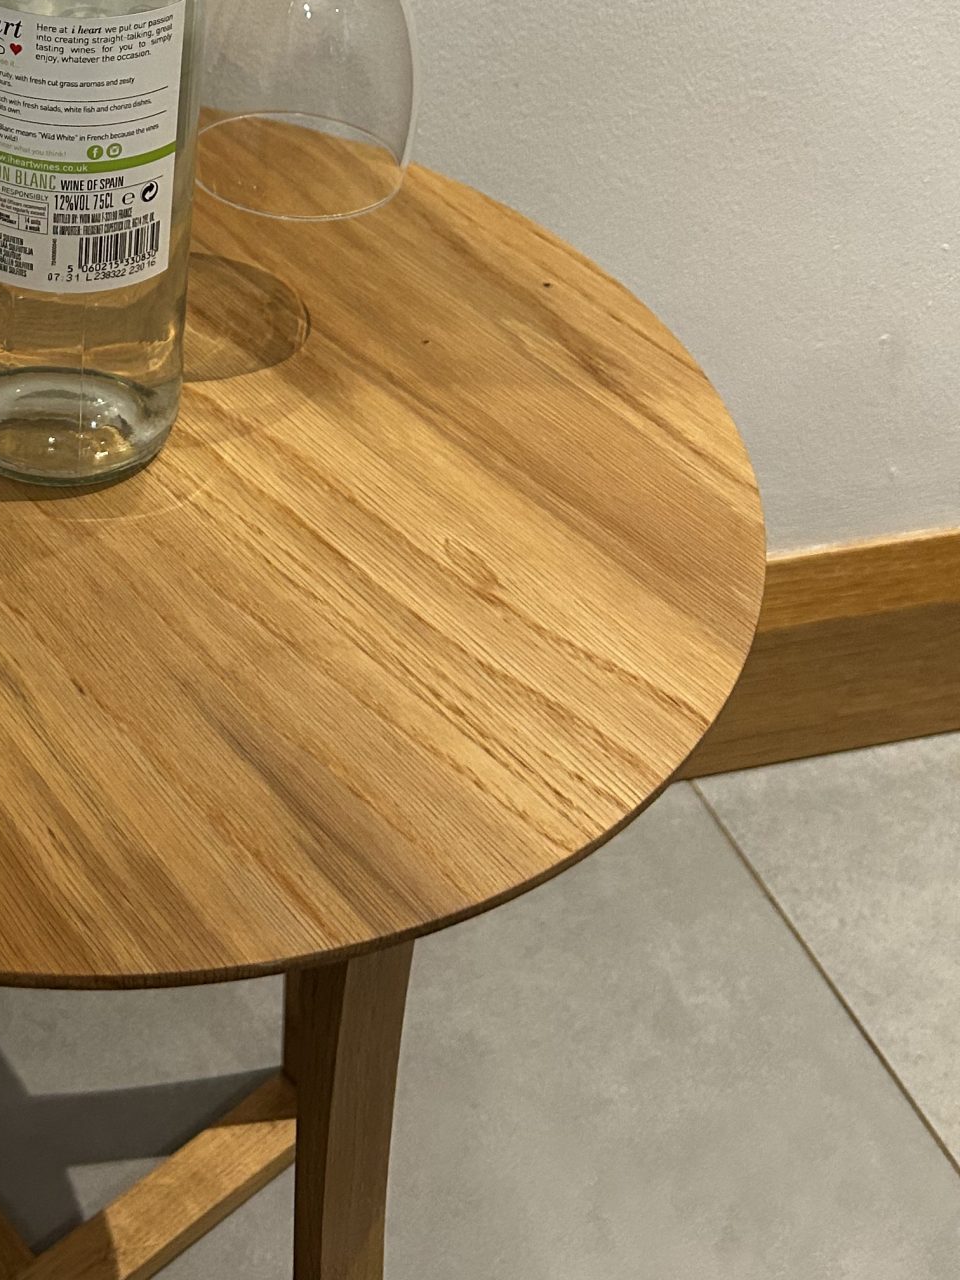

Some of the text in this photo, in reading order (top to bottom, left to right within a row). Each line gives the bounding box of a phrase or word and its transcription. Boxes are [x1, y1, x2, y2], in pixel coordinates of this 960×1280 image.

[36, 23, 57, 33] Here
[78, 25, 102, 34] heart
[119, 24, 132, 35] put
[133, 21, 147, 29] our
[148, 14, 173, 28] passion
[36, 35, 52, 43] into
[54, 35, 89, 46] creating
[155, 23, 173, 36] great
[36, 43, 64, 54] tasting
[102, 45, 113, 53] for
[119, 43, 133, 53] you
[151, 32, 173, 46] simply
[61, 55, 100, 64] whatever
[102, 54, 115, 62] the
[117, 49, 152, 61] occasion.
[15, 74, 28, 82] with
[29, 76, 47, 85] fresh
[59, 81, 79, 89] grass
[106, 79, 118, 87] and
[119, 76, 136, 85] zesty
[9, 97, 22, 106] with
[22, 100, 39, 110] fresh
[96, 104, 109, 112] and
[16, 129, 37, 138] means
[86, 131, 110, 141] French
[110, 129, 135, 139] because
[135, 127, 145, 135] the
[15, 170, 57, 190] BLANC
[60, 179, 85, 191] WINE
[87, 179, 98, 190] OF
[100, 176, 124, 190] SPAIN
[1, 186, 49, 202] RESPONSIBLY
[54, 194, 90, 211] 12%VOL
[93, 193, 114, 210] 75CL
[67, 264, 74, 273] 5
